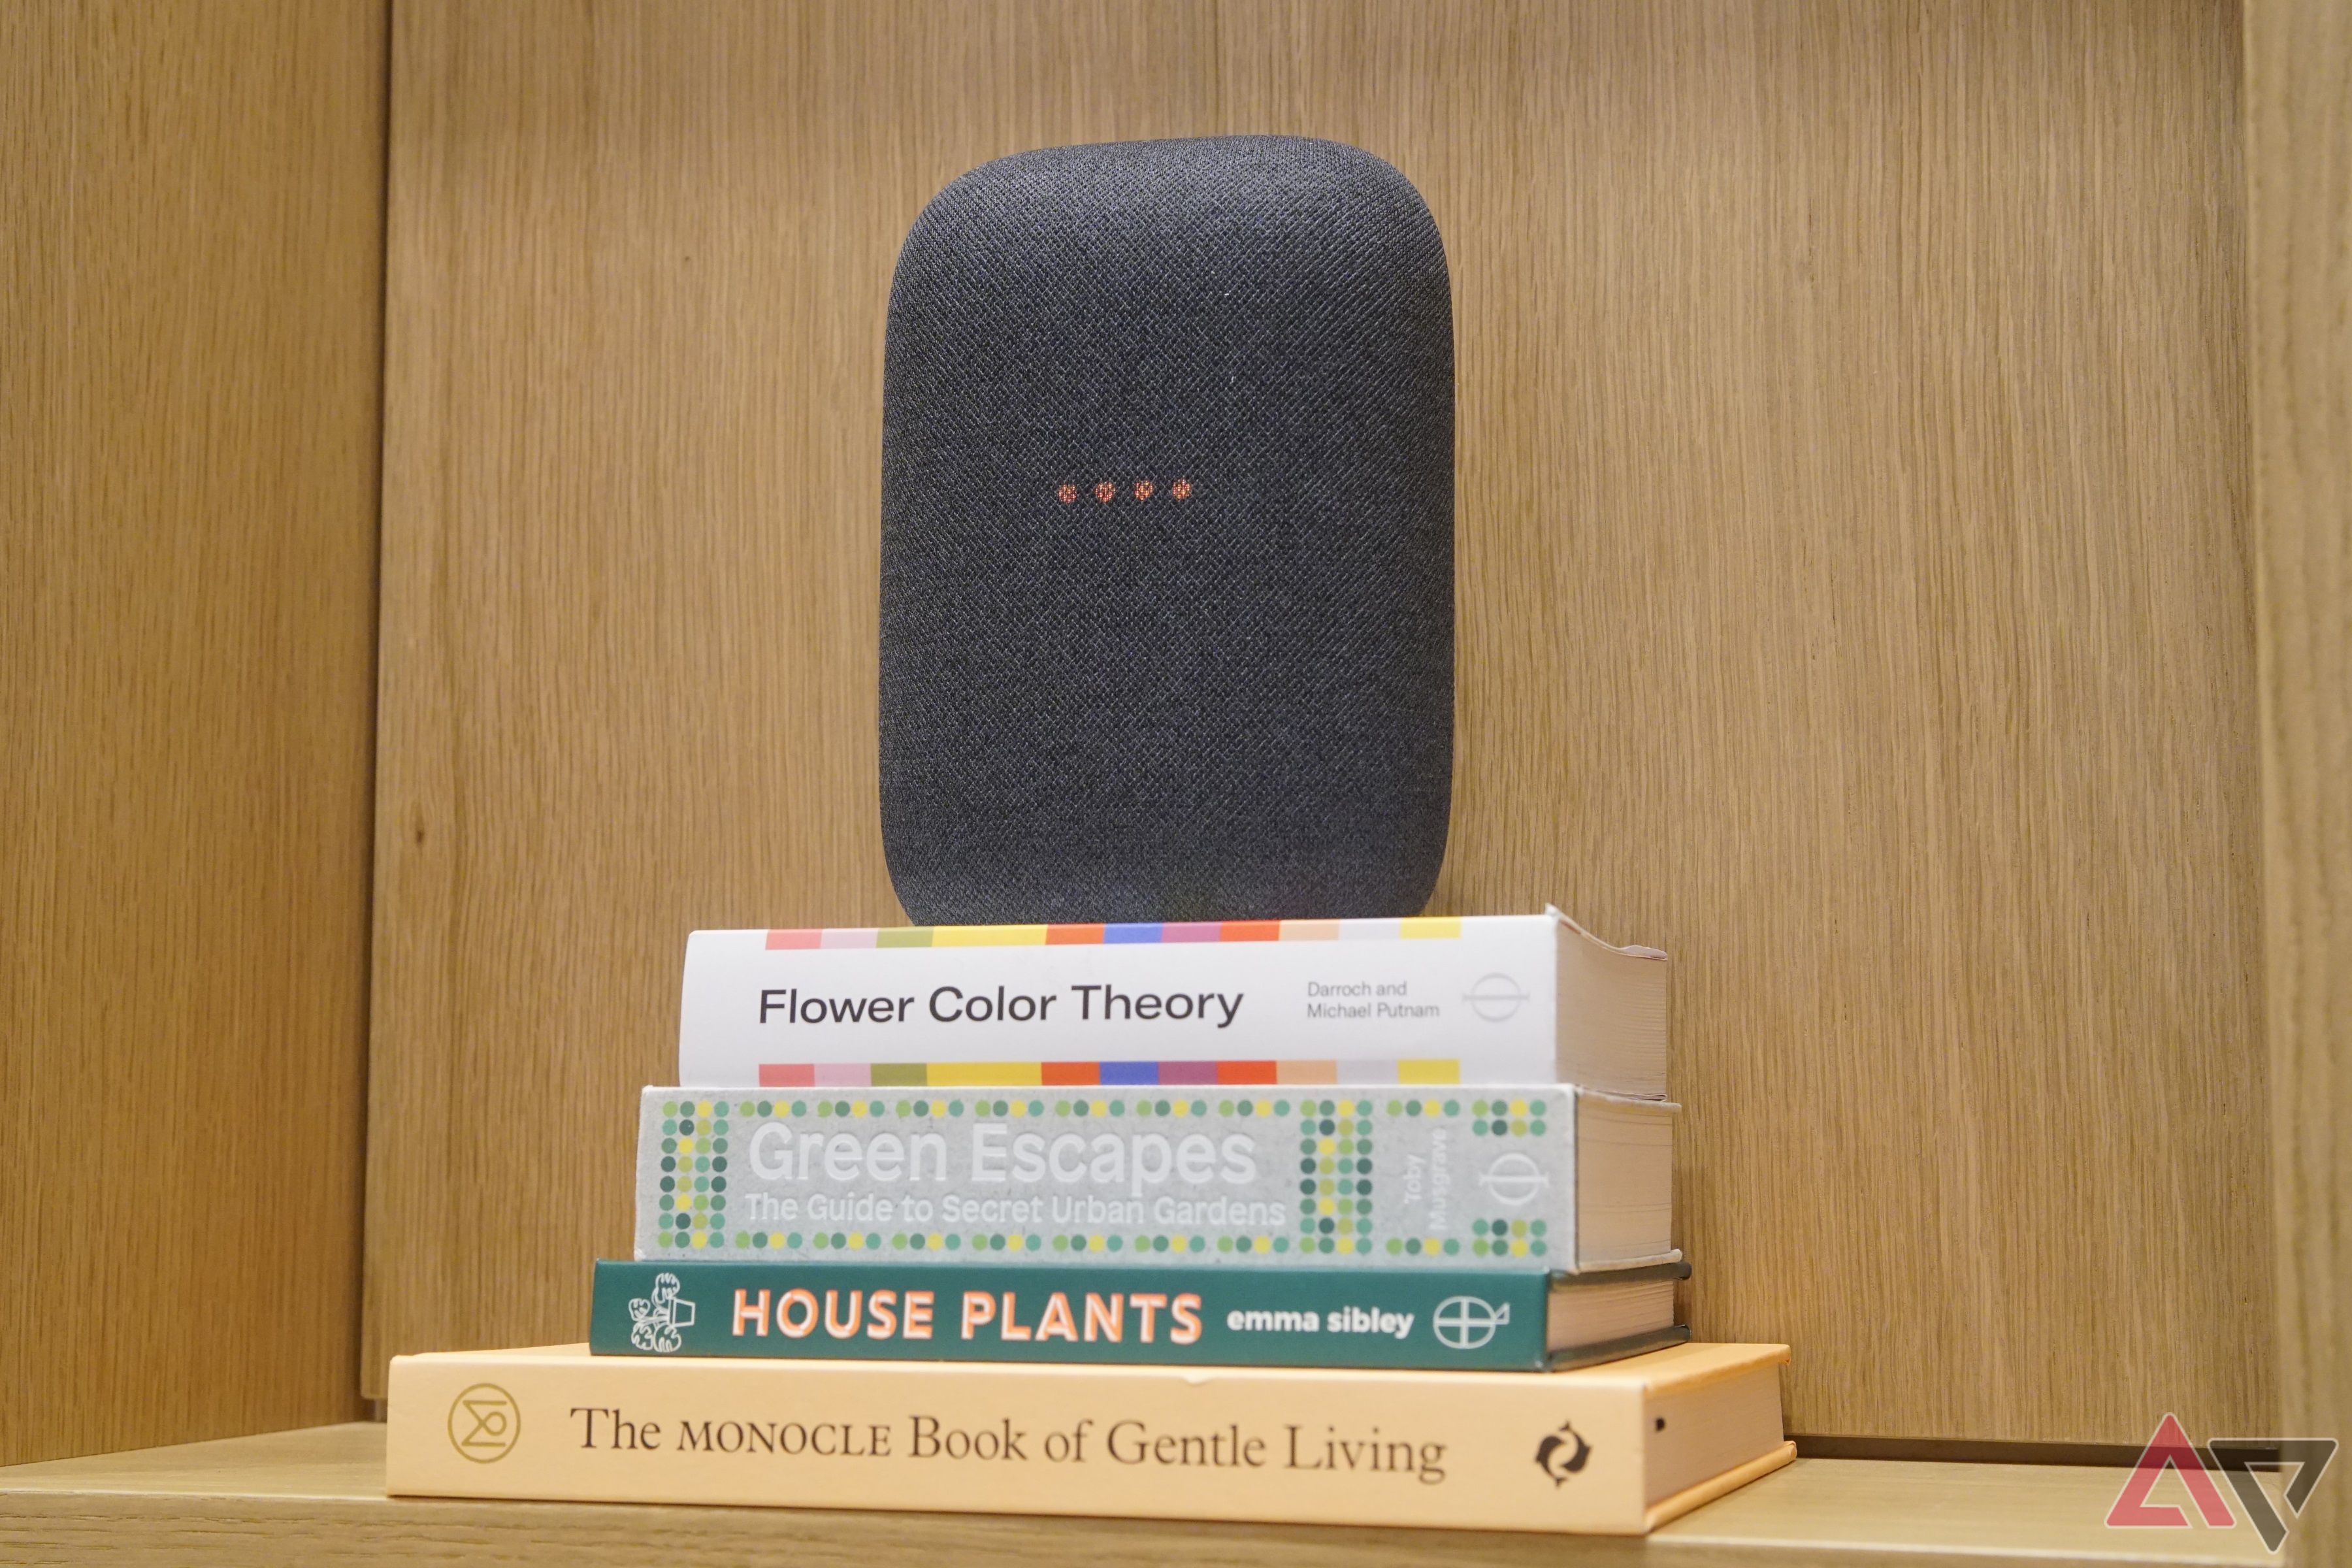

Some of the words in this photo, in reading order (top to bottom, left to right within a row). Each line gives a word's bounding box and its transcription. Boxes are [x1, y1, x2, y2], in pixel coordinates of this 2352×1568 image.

[759, 988, 914, 1024] Flower
[928, 985, 1057, 1023] Color
[1071, 984, 1245, 1028] Theory
[1307, 981, 1372, 998] Darroch
[1376, 980, 1407, 996] and
[1307, 1001, 1371, 1019] Michael
[1377, 1002, 1440, 1018] Putnam
[748, 1121, 947, 1183] Green
[972, 1122, 1257, 1197] Escapes
[1404, 1154, 1426, 1205] Toby
[745, 1192, 798, 1221] The
[806, 1193, 894, 1223] Guide
[901, 1194, 934, 1223] to
[941, 1194, 1044, 1224] Secret
[1052, 1194, 1144, 1225] Urban
[1154, 1195, 1286, 1228] Gardens
[732, 1288, 935, 1341] HOUSE
[960, 1290, 1203, 1345] PLANTS
[1227, 1311, 1320, 1333] emma
[1327, 1307, 1415, 1339] sibley
[570, 1407, 661, 1450] The
[676, 1420, 892, 1458] MONOCLE
[908, 1415, 1028, 1460] Book
[1045, 1419, 1094, 1463] of
[1106, 1420, 1267, 1468] Gentle
[1283, 1424, 1447, 1485] Living
